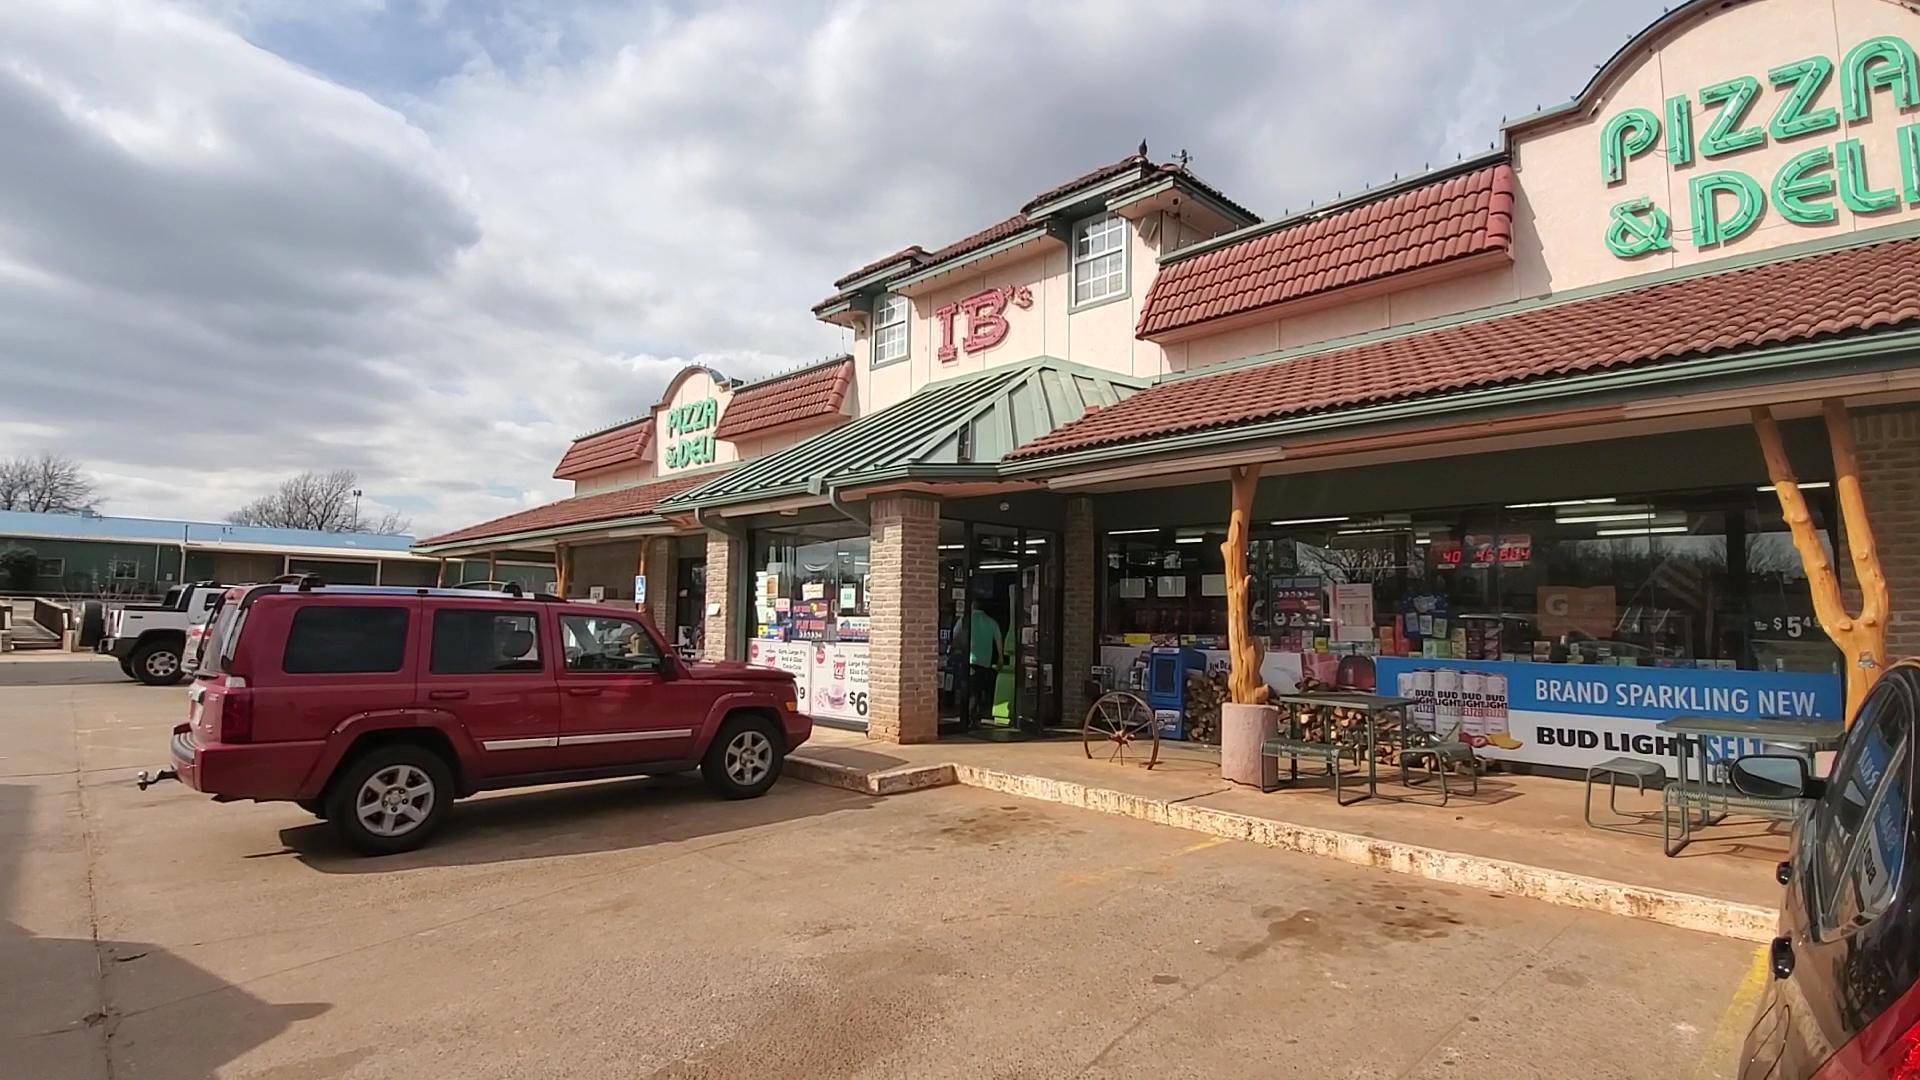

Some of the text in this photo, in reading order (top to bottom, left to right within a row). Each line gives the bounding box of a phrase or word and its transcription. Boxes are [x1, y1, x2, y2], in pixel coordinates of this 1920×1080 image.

[1600, 35, 1920, 184] PIZZA
[1604, 122, 1920, 258] & DELI
[666, 397, 717, 437] PIZZA
[678, 432, 715, 467] DELI
[1415, 689, 1434, 697] BUD
[1437, 691, 1458, 699] BUD
[1461, 692, 1482, 700] BUD
[1485, 694, 1505, 702] BUD
[1535, 679, 1822, 718] BRAND SPARKLING NEW.
[1536, 726, 1599, 749] BUD
[1604, 731, 1700, 758] LIGHT
